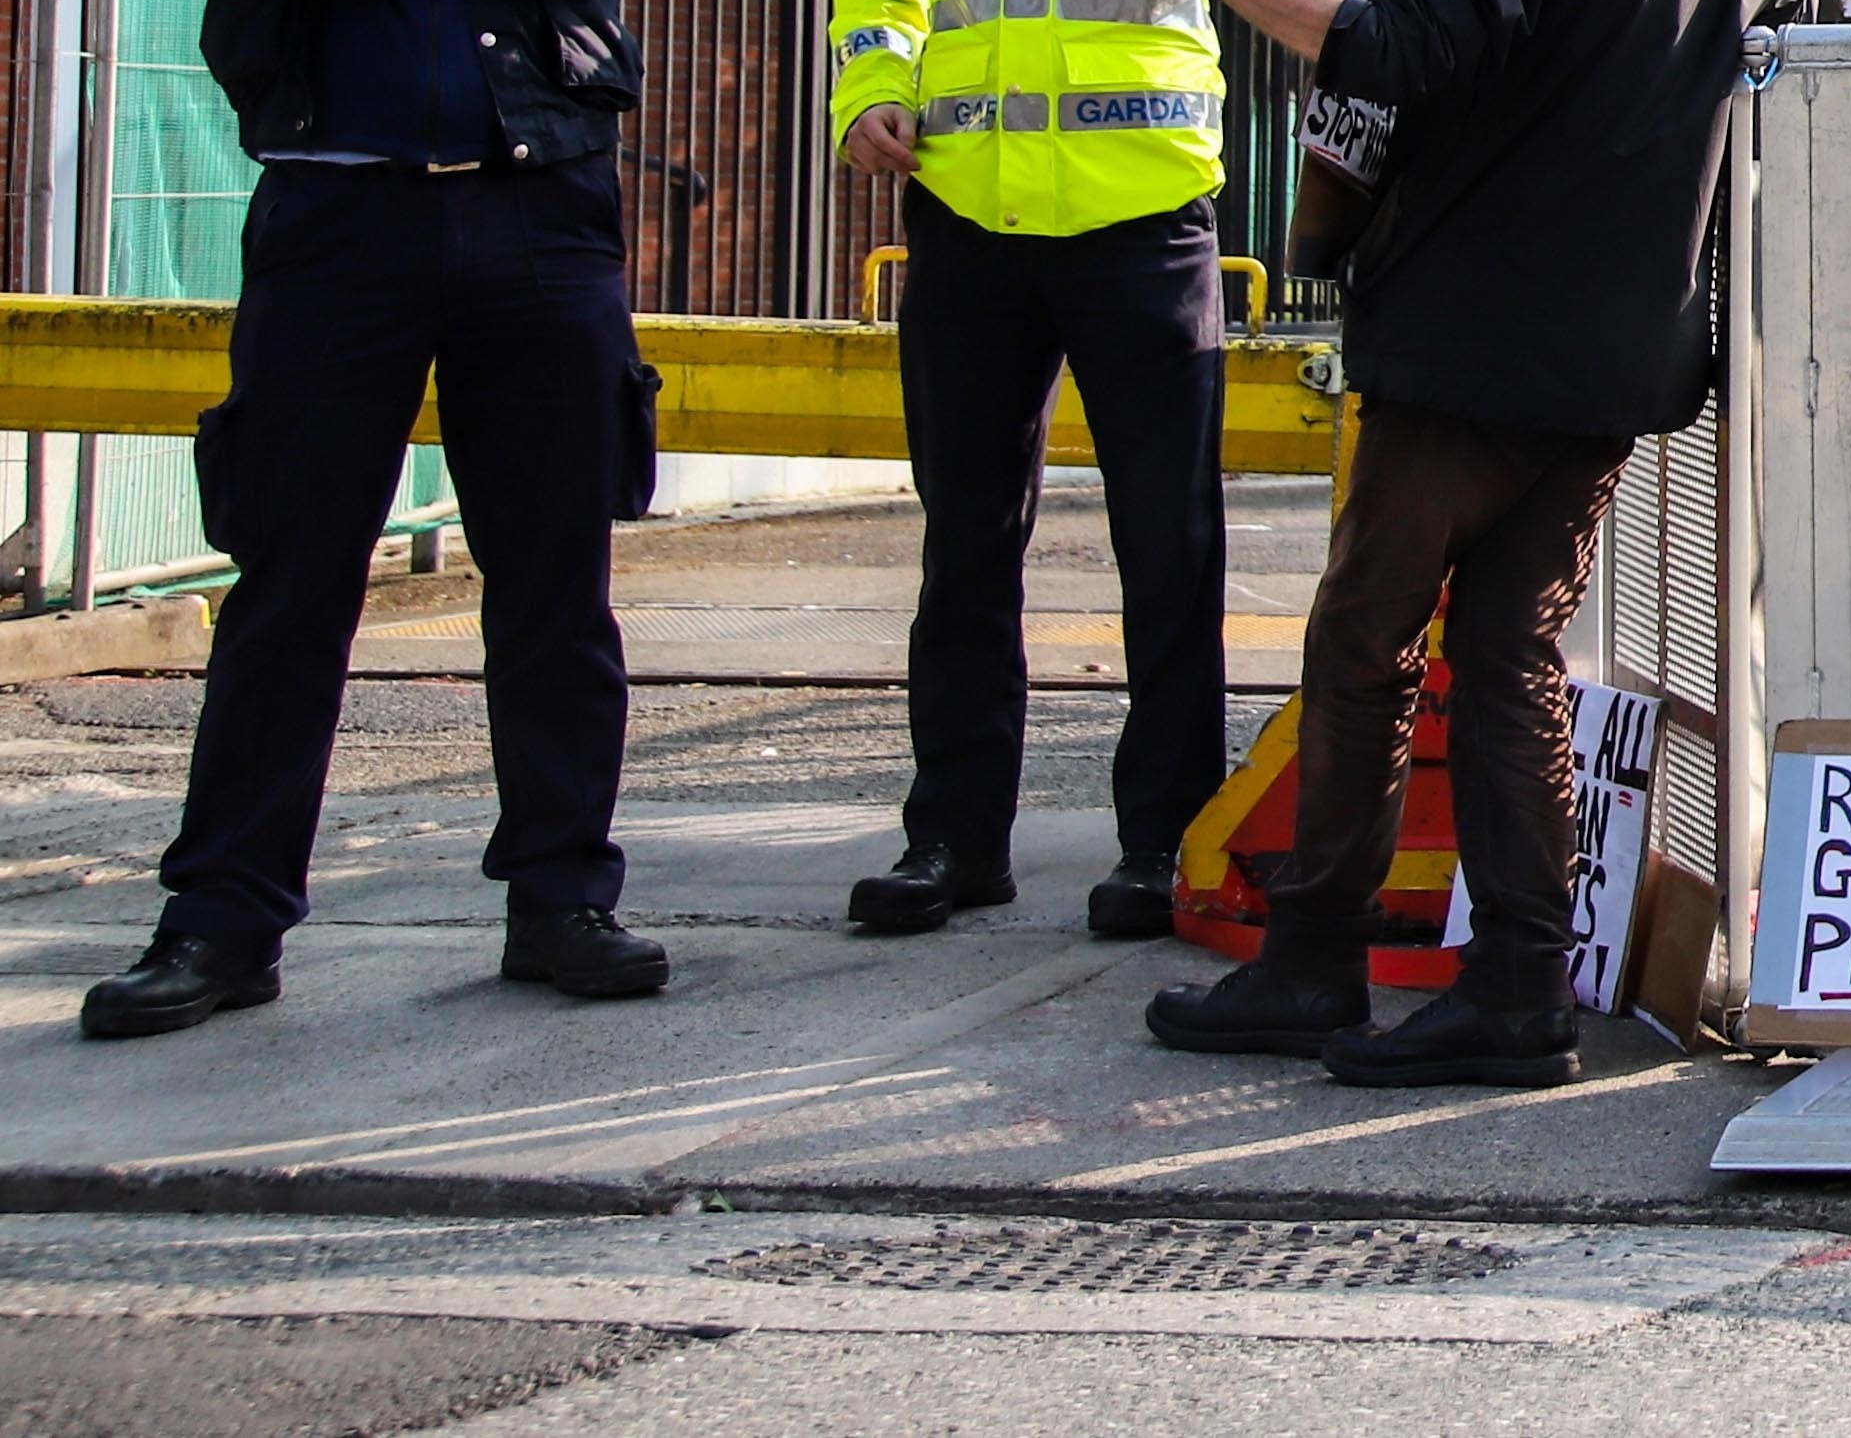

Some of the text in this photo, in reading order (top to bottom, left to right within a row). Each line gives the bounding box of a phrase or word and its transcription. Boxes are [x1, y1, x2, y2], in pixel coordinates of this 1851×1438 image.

[1076, 97, 1191, 124] GARDA
[1307, 93, 1363, 160] STOP
[1593, 691, 1650, 791] ALL
